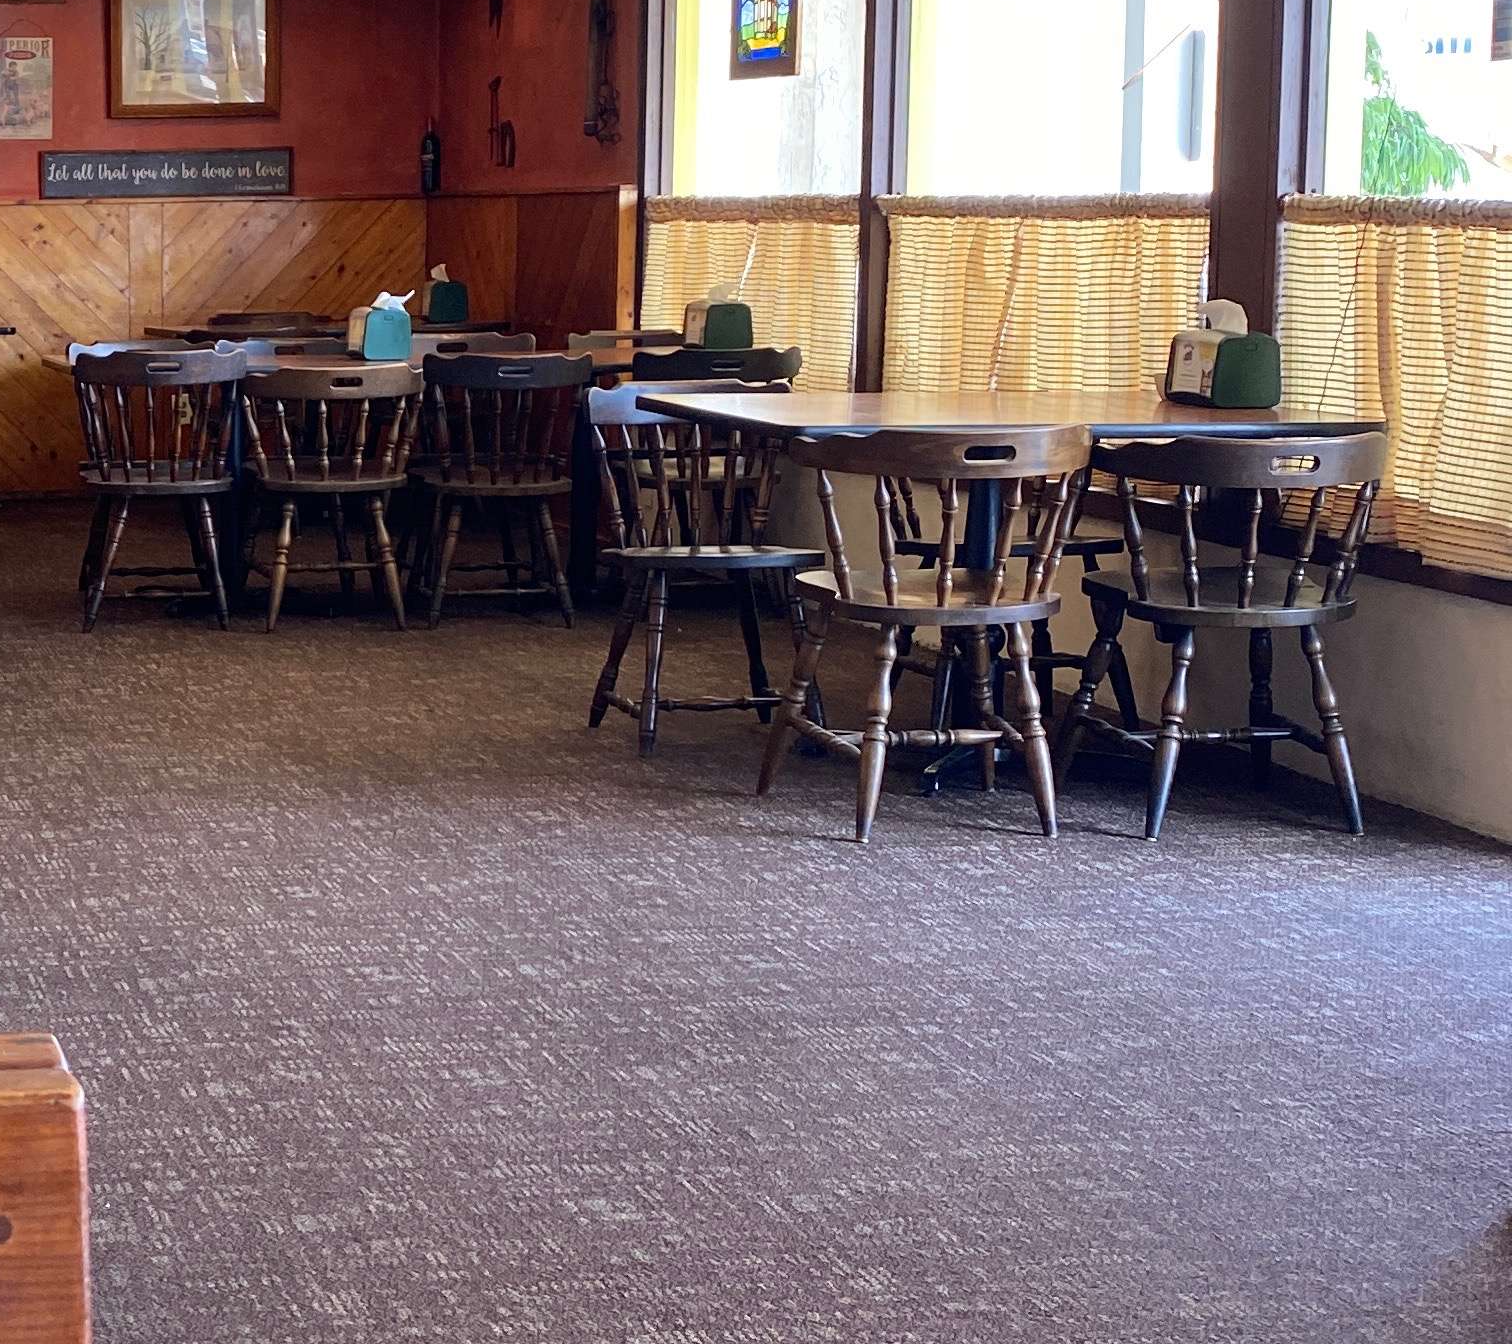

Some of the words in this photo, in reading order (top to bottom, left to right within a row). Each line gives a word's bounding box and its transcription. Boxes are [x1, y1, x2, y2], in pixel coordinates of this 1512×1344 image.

[48, 163, 69, 182] Let
[73, 163, 94, 181] all
[98, 163, 128, 181] that
[131, 168, 158, 185] you
[160, 162, 178, 180] do
[181, 162, 199, 179] be
[201, 161, 235, 179] done
[237, 165, 252, 178] in
[255, 160, 285, 177] love
